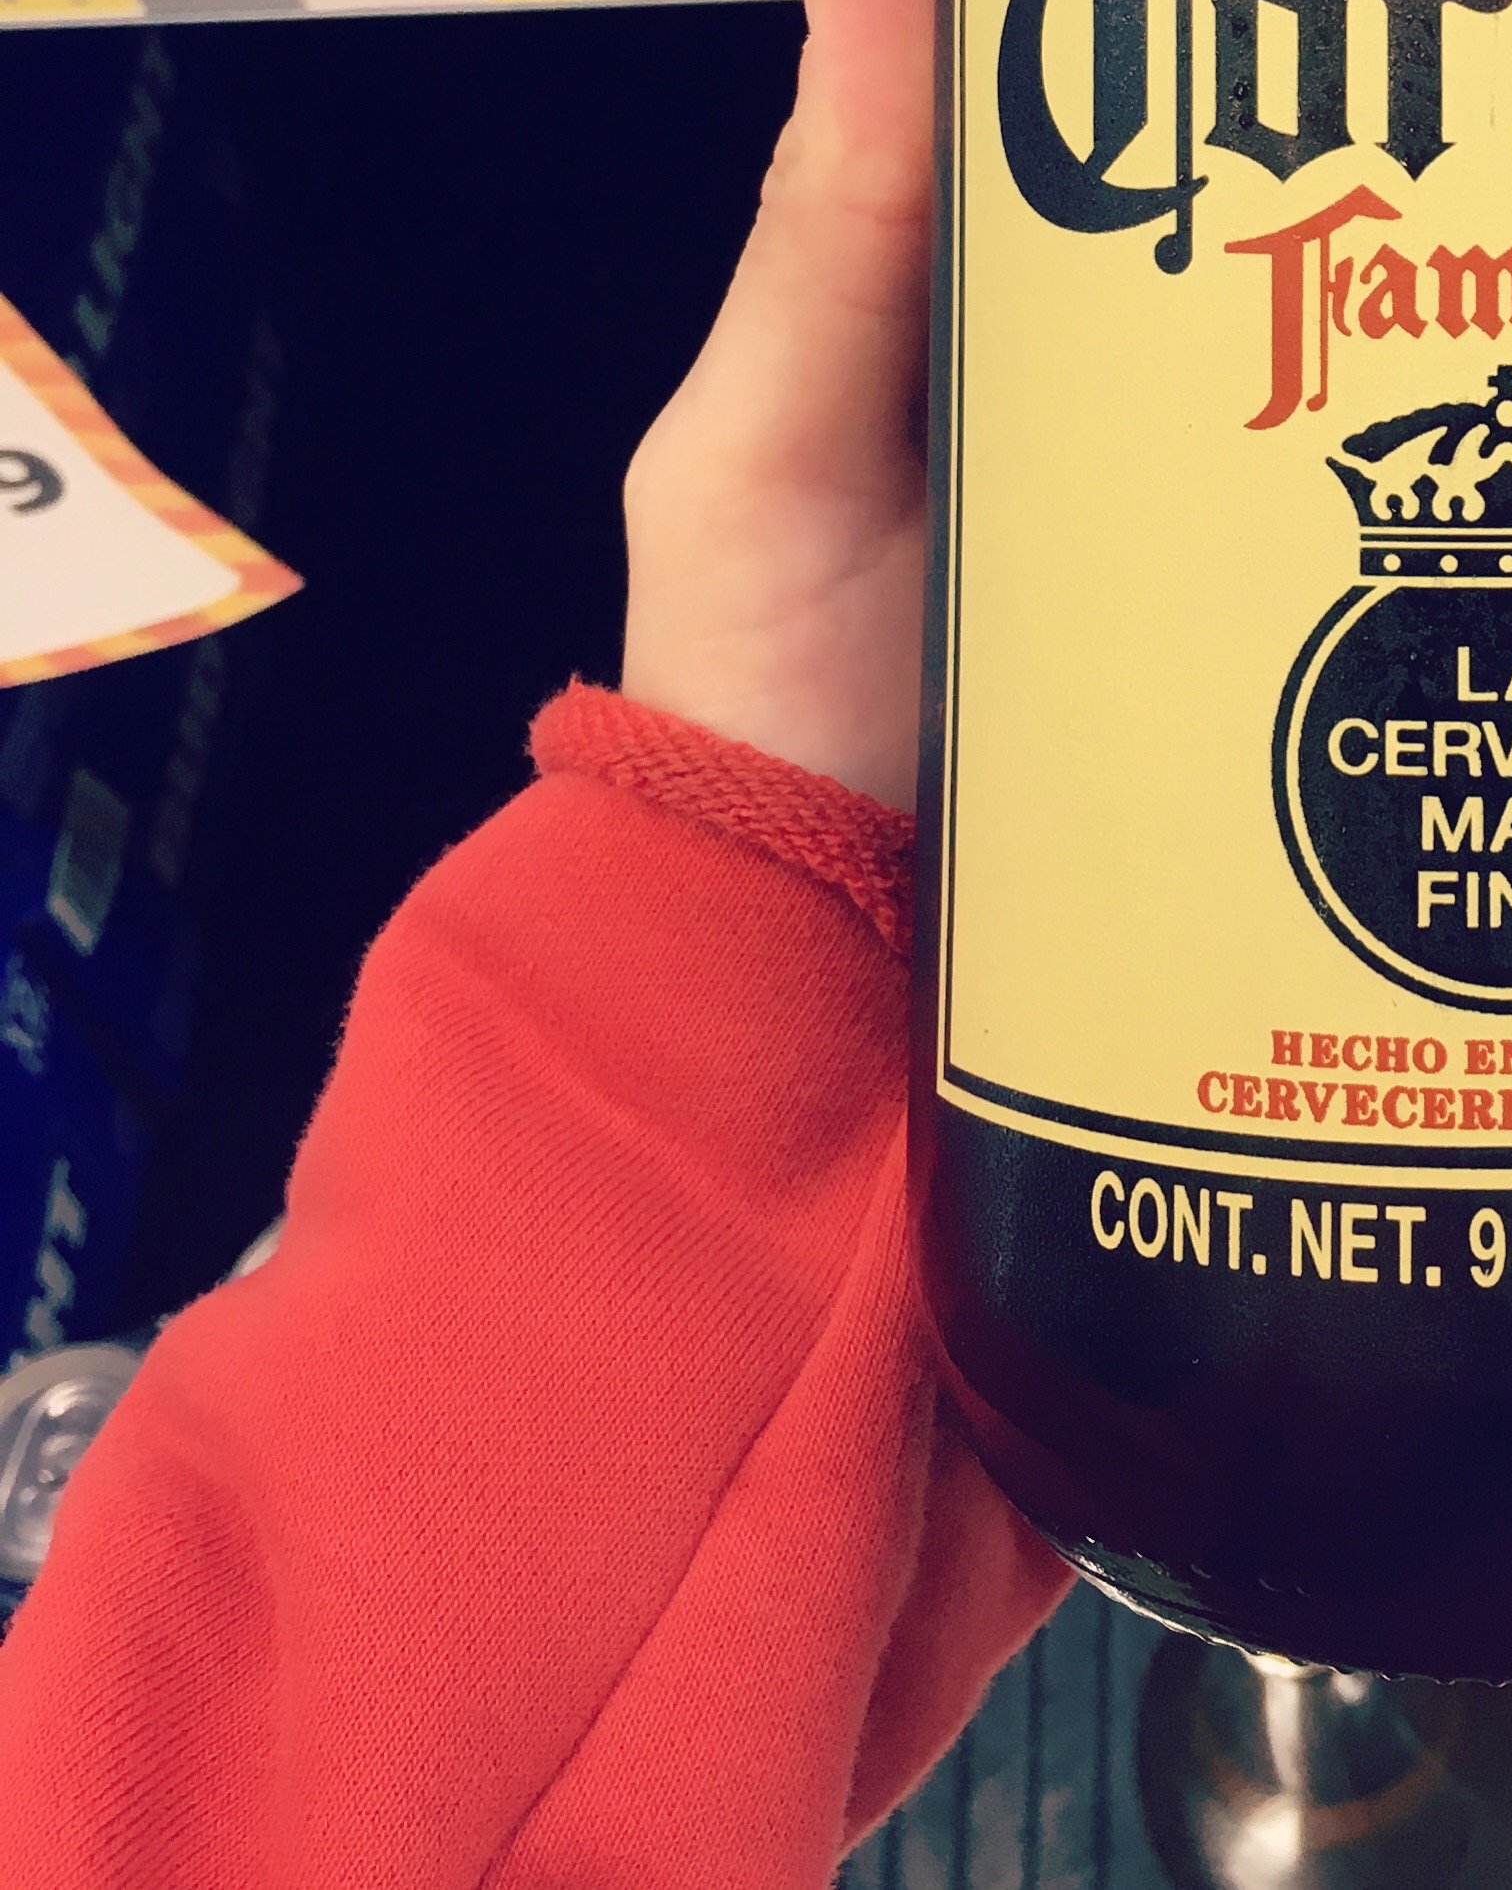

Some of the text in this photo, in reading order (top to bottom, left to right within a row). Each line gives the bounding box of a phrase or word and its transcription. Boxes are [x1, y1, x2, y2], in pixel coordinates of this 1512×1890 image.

[1270, 1029, 1450, 1076] HECHO
[1090, 1170, 1269, 1275] CONT.
[1290, 1198, 1441, 1288] NET.
